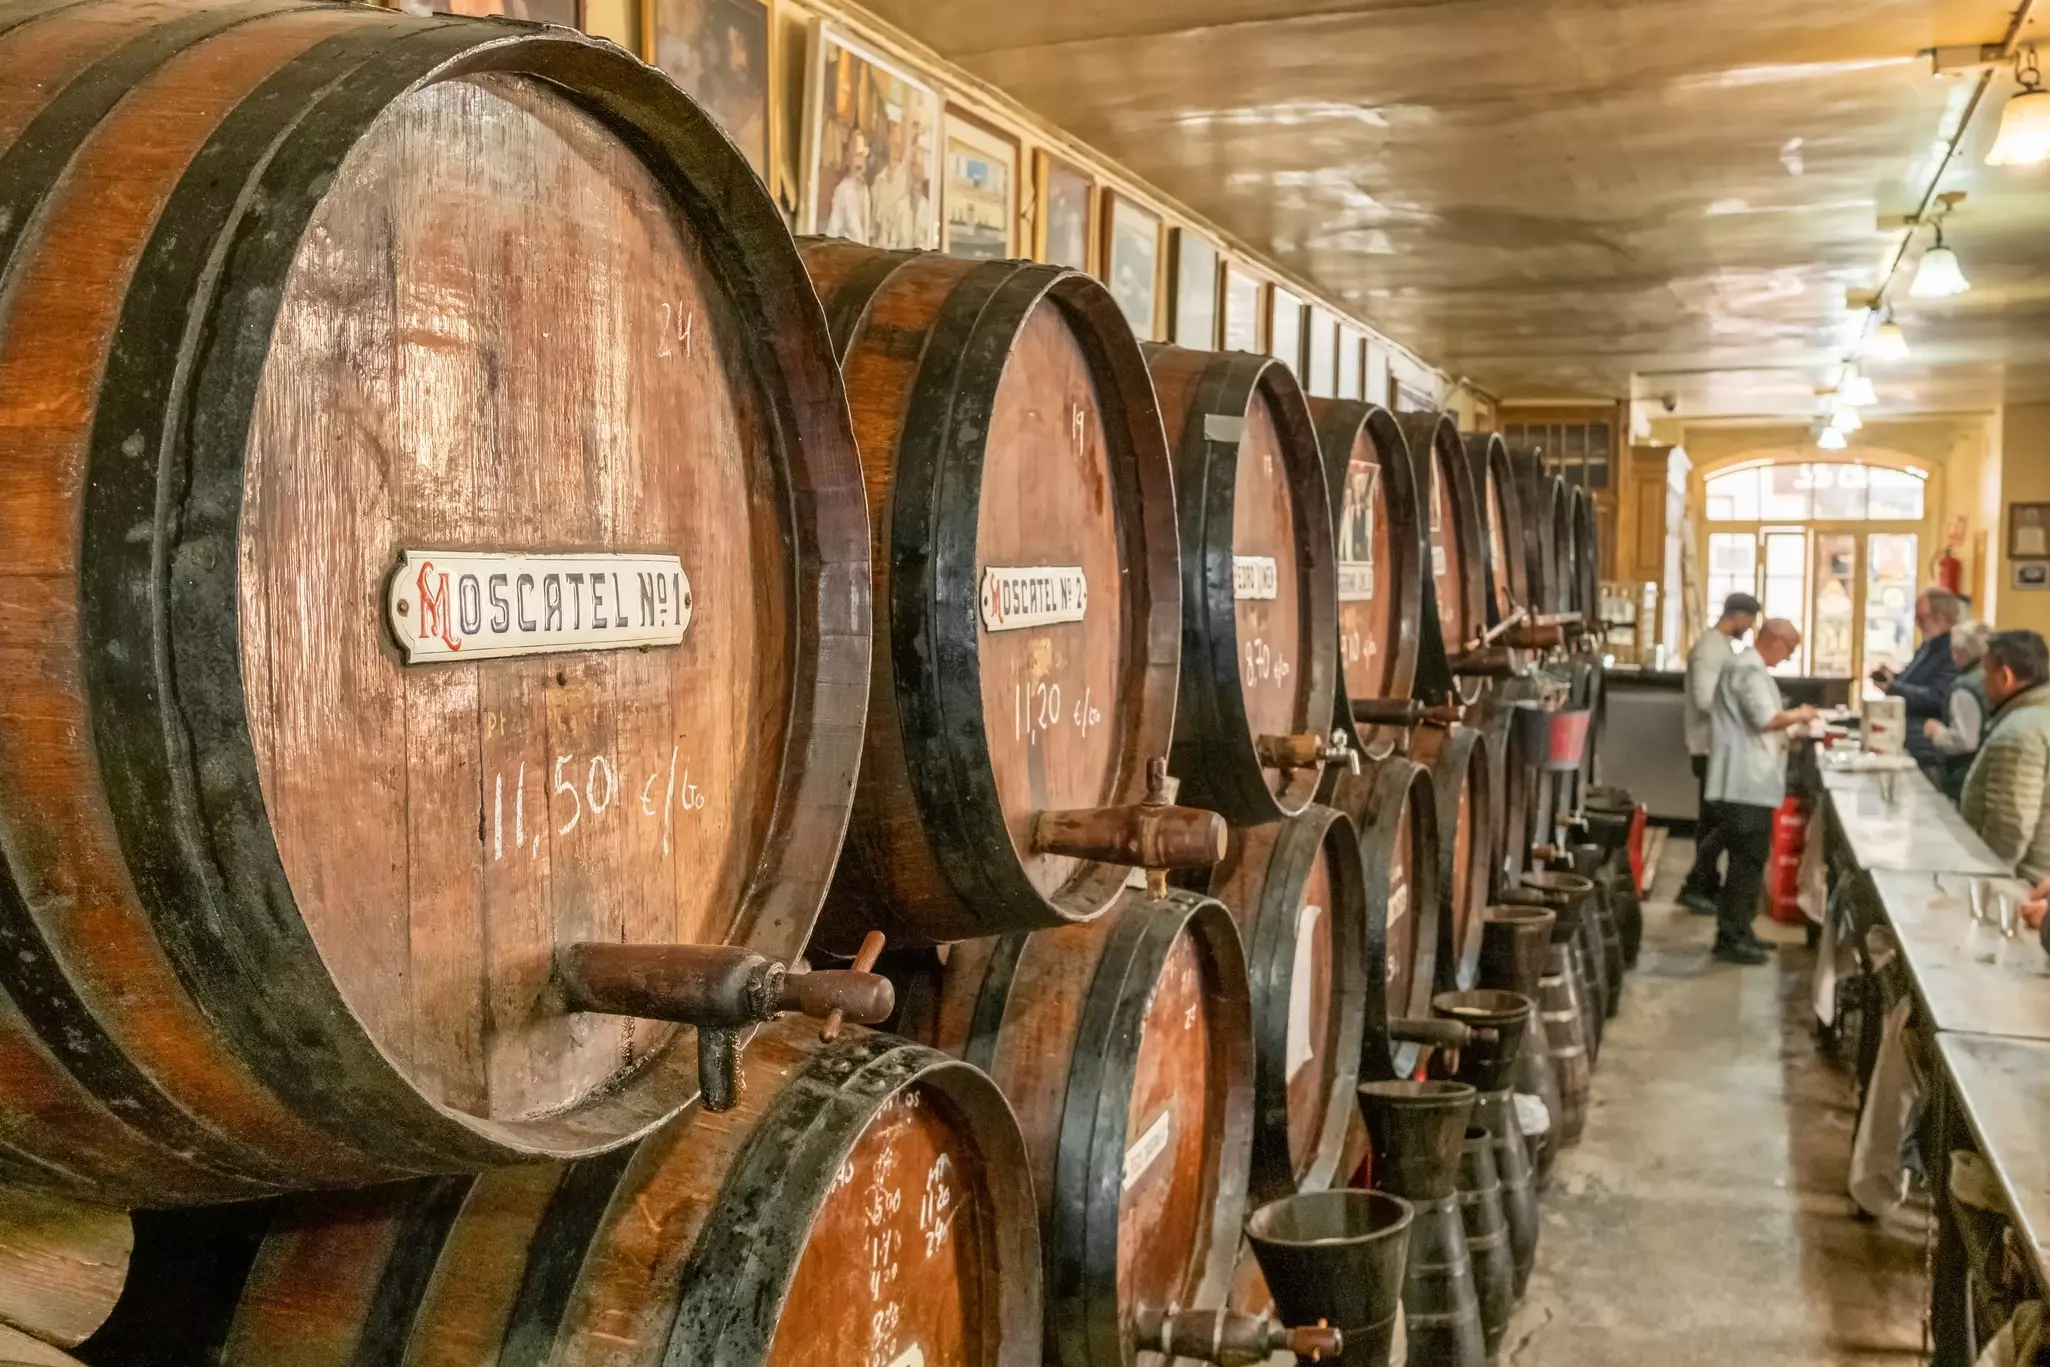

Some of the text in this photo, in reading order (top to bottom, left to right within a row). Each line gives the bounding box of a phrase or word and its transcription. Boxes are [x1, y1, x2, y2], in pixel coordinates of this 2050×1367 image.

[659, 299, 692, 361] 24
[1071, 402, 1085, 456] 19
[416, 561, 629, 651] MOSCATEL
[990, 573, 1058, 624] MOSCATEL
